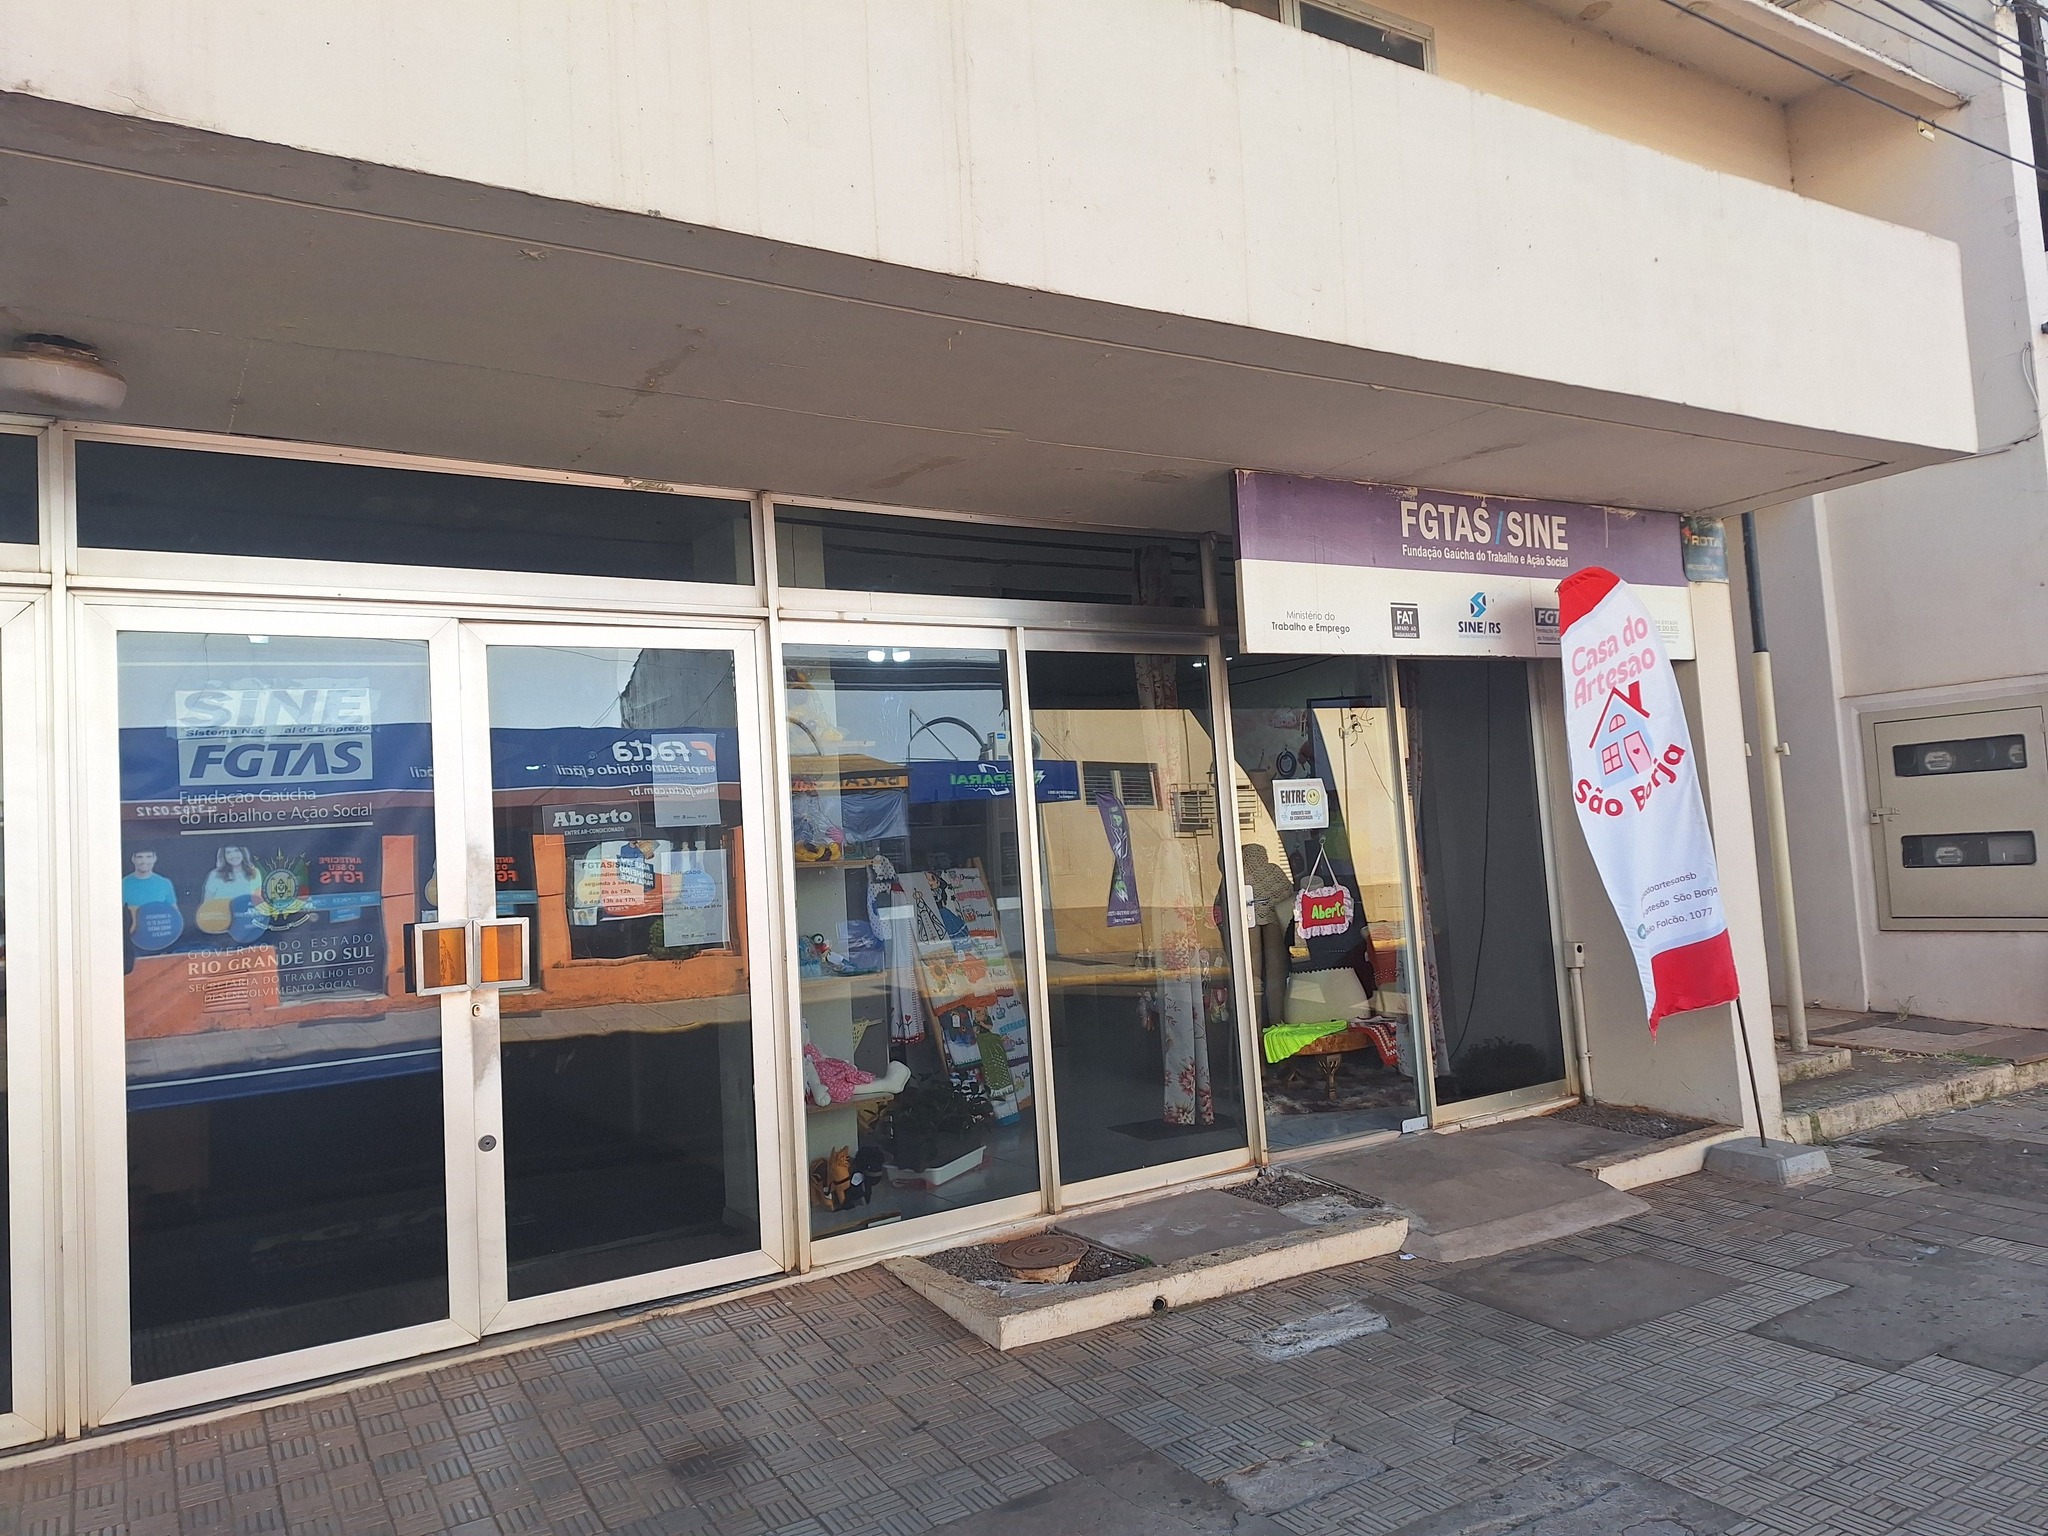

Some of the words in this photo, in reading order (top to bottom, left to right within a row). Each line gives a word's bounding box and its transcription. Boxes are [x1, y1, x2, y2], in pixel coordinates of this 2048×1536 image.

[1402, 544, 1443, 560] Fundação
[1444, 548, 1474, 560] Gaúcha
[1476, 550, 1486, 561] do
[1487, 551, 1519, 564] Trabalho
[1520, 556, 1525, 564] e
[1526, 554, 1545, 568] Ação
[1546, 556, 1569, 568] Social
[1286, 610, 1322, 621] Ministério
[1324, 612, 1336, 621] do
[1396, 611, 1413, 625] FAT
[1271, 622, 1307, 632] Trabalho
[1308, 624, 1314, 632] e
[1316, 623, 1350, 635] Emprego
[1458, 621, 1501, 634] SINE/RS
[1572, 635, 1619, 676] Casa
[1623, 615, 1648, 647] do
[1574, 647, 1656, 710] Artesão
[186, 728, 238, 737] Sistema
[317, 725, 370, 734] Emprego
[189, 741, 363, 779] FGTAS
[1575, 779, 1623, 816] São
[1630, 744, 1686, 812] Borja
[179, 790, 254, 808] Fundação
[258, 787, 316, 802] Gaúcha
[1280, 790, 1306, 804] ENTRE
[179, 810, 200, 825] do
[206, 808, 272, 824] Trabalho
[276, 810, 286, 821] e
[290, 805, 330, 824] Ação
[333, 802, 372, 818] Social
[553, 808, 633, 828] Aberto
[1673, 893, 1692, 903] São
[1694, 886, 1718, 899] Borja
[1656, 915, 1688, 928] Falcão,
[1689, 907, 1713, 920] 1077
[187, 943, 269, 960] GOVERNO
[279, 940, 300, 951] DO
[311, 933, 374, 948] ESTADO
[188, 962, 221, 976] RIO
[228, 953, 304, 972] GRANDE
[311, 949, 337, 963] DO
[342, 945, 375, 960] SUL
[262, 974, 280, 985] DO
[283, 969, 344, 983] TRABALHO
[347, 967, 353, 976] E
[357, 966, 374, 976] DO
[318, 977, 360, 991] SOCIAL
